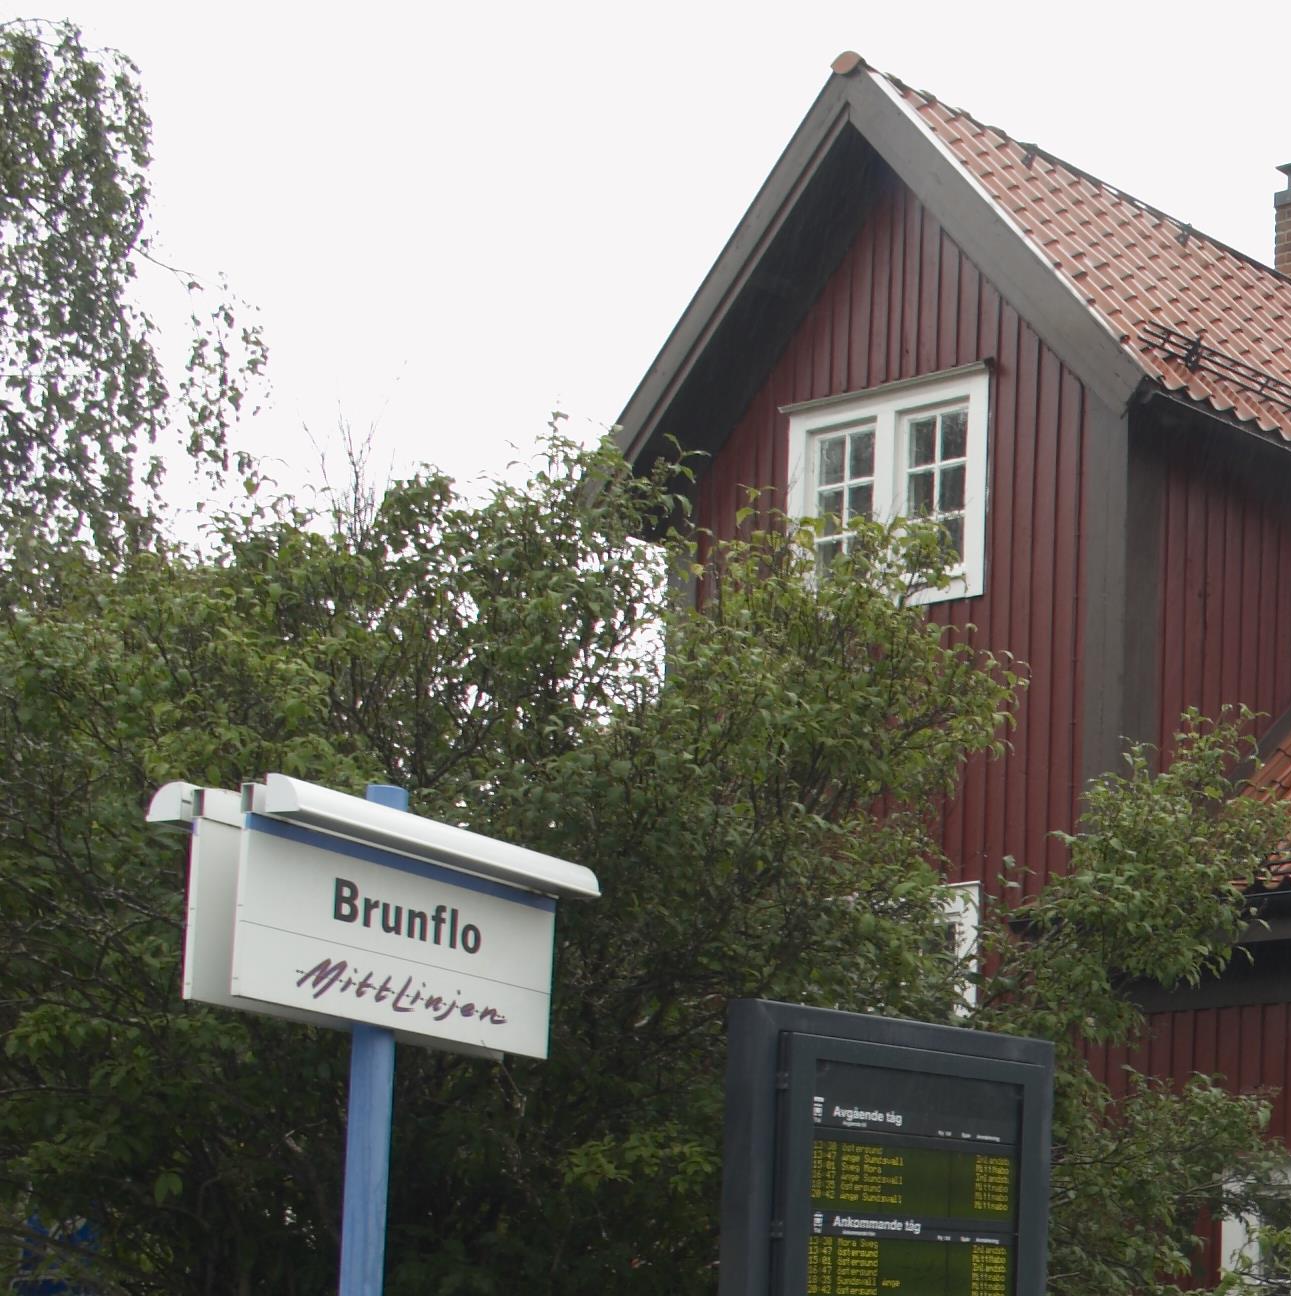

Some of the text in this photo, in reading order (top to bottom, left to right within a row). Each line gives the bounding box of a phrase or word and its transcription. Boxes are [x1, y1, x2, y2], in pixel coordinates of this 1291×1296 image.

[334, 877, 482, 954] Brunflo
[833, 1105, 885, 1123] Avgående
[886, 1110, 903, 1126] tåg
[833, 1215, 922, 1234] Ankommande tåg
